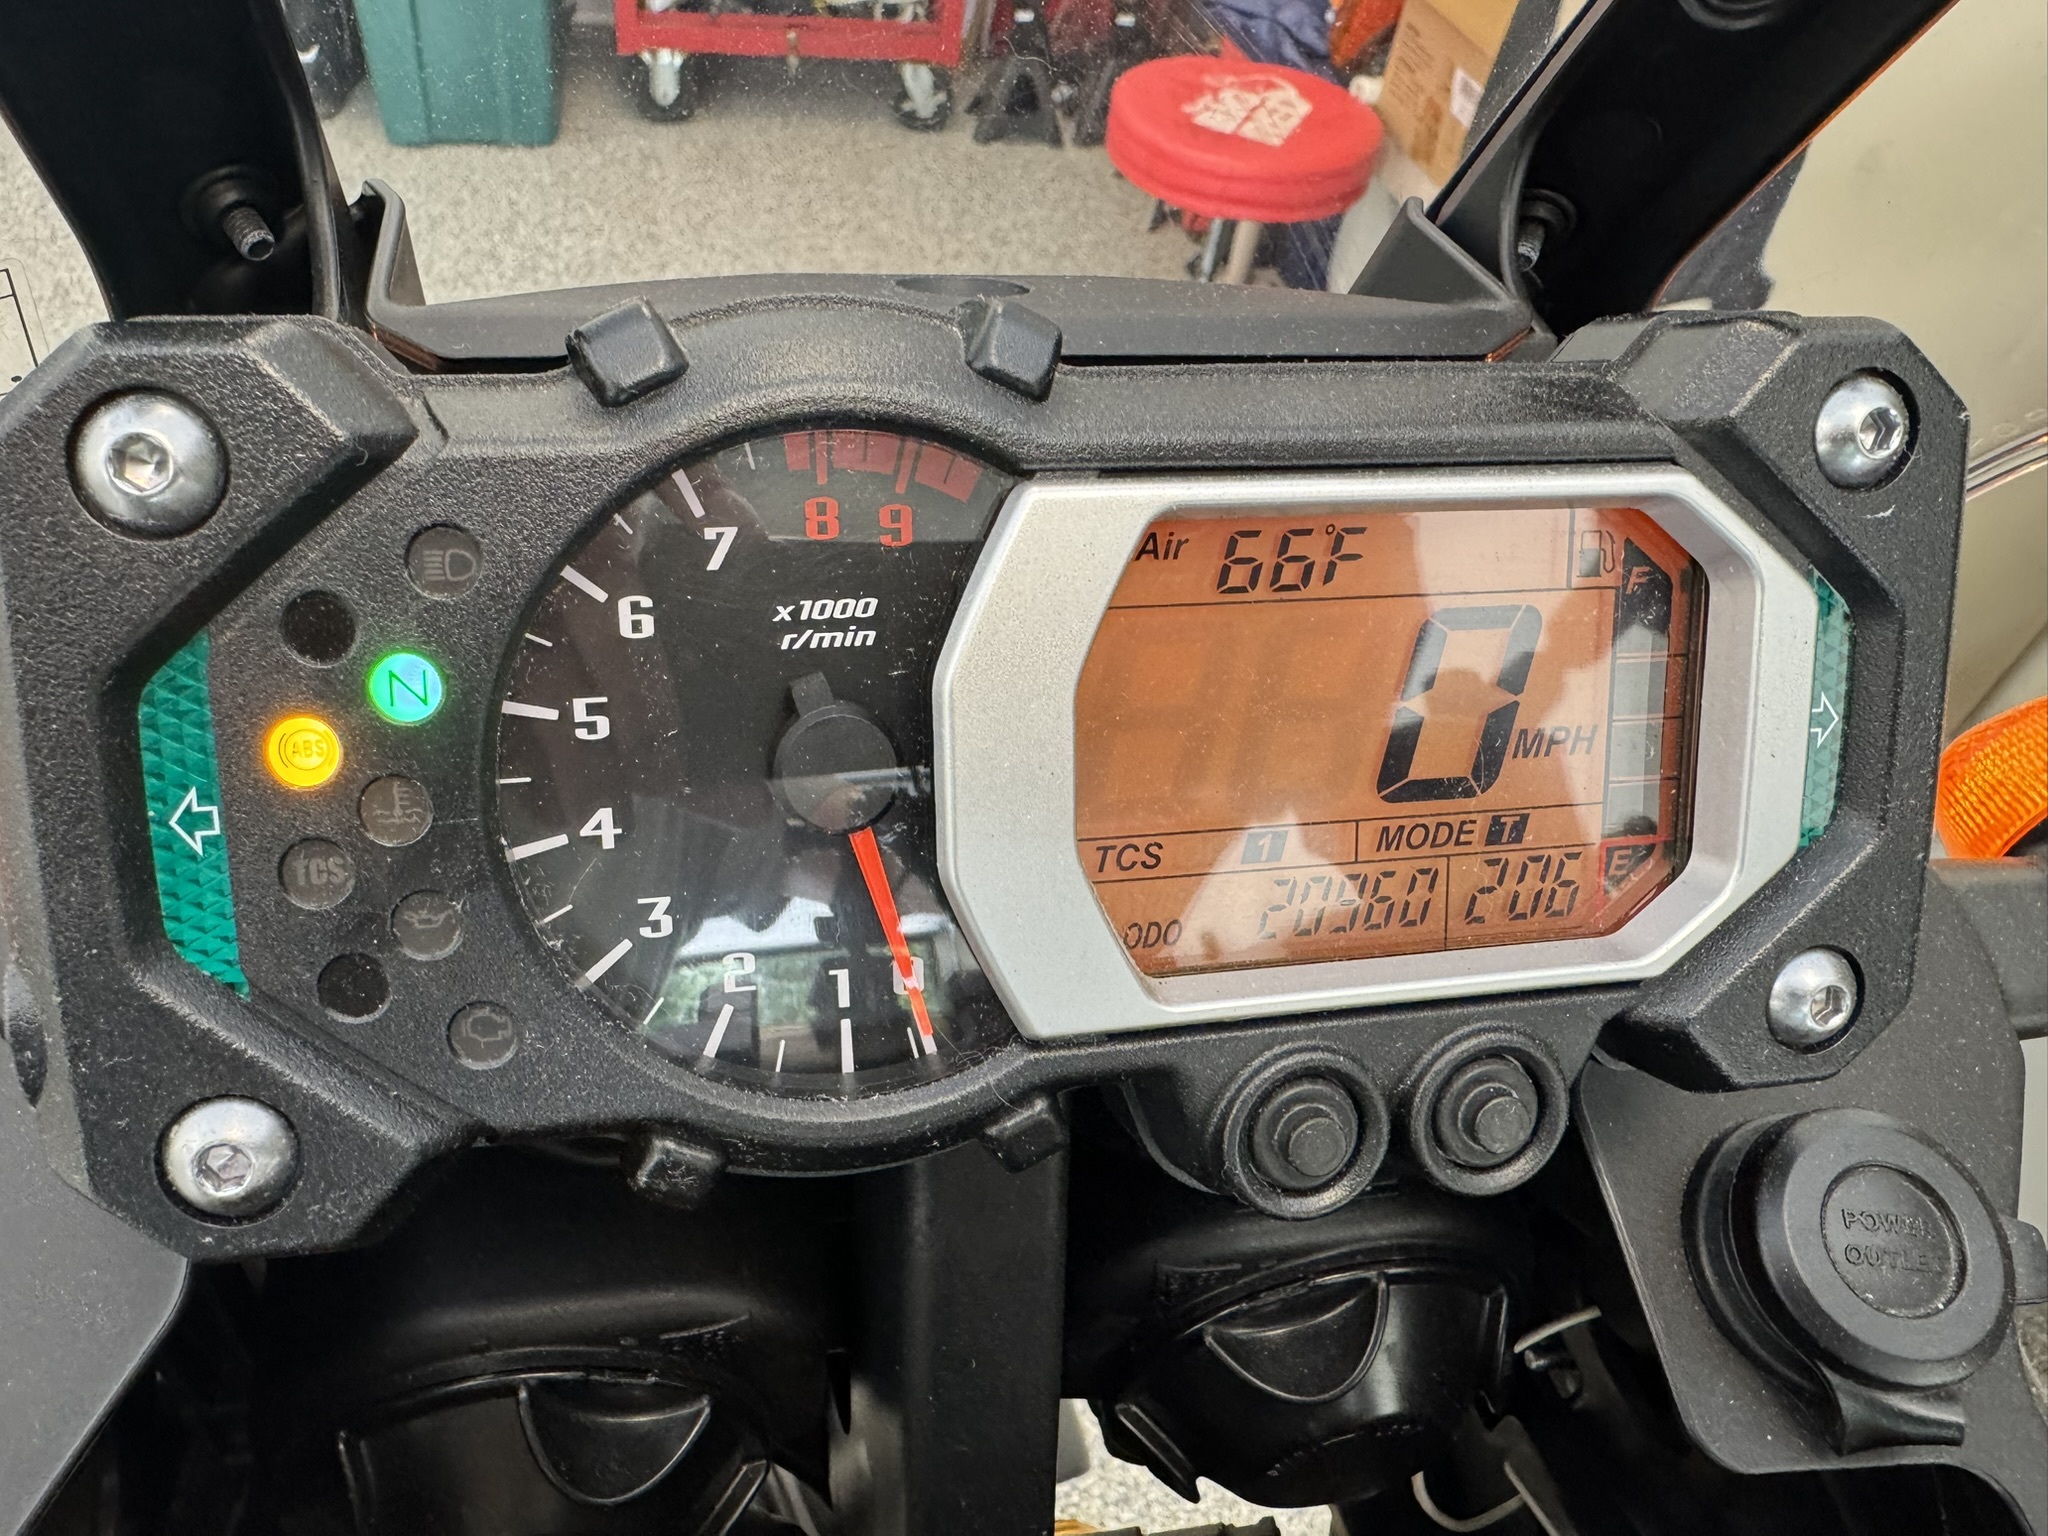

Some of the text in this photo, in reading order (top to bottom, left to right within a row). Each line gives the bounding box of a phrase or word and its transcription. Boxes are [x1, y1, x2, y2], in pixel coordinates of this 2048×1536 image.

[805, 496, 840, 541] 8
[878, 503, 914, 548] 9
[703, 526, 738, 571] 7
[1134, 531, 1190, 562] Air
[1625, 565, 1653, 595] F
[617, 596, 655, 639] 6
[772, 597, 879, 623] x1000
[780, 625, 877, 650] r/min
[388, 669, 429, 707] N
[1375, 604, 1598, 804] 0 MPH
[572, 697, 610, 740] 5
[291, 737, 325, 760] ABS
[579, 807, 623, 850] 4
[1375, 820, 1476, 853] MODE
[293, 854, 346, 886] TCS
[1096, 840, 1164, 874] TCS
[637, 896, 674, 939] 3
[1123, 918, 1184, 950] ODO
[723, 952, 758, 993] 2
[828, 968, 851, 1008] 1
[892, 956, 925, 996] 0
[1841, 1207, 1936, 1239] POWER
